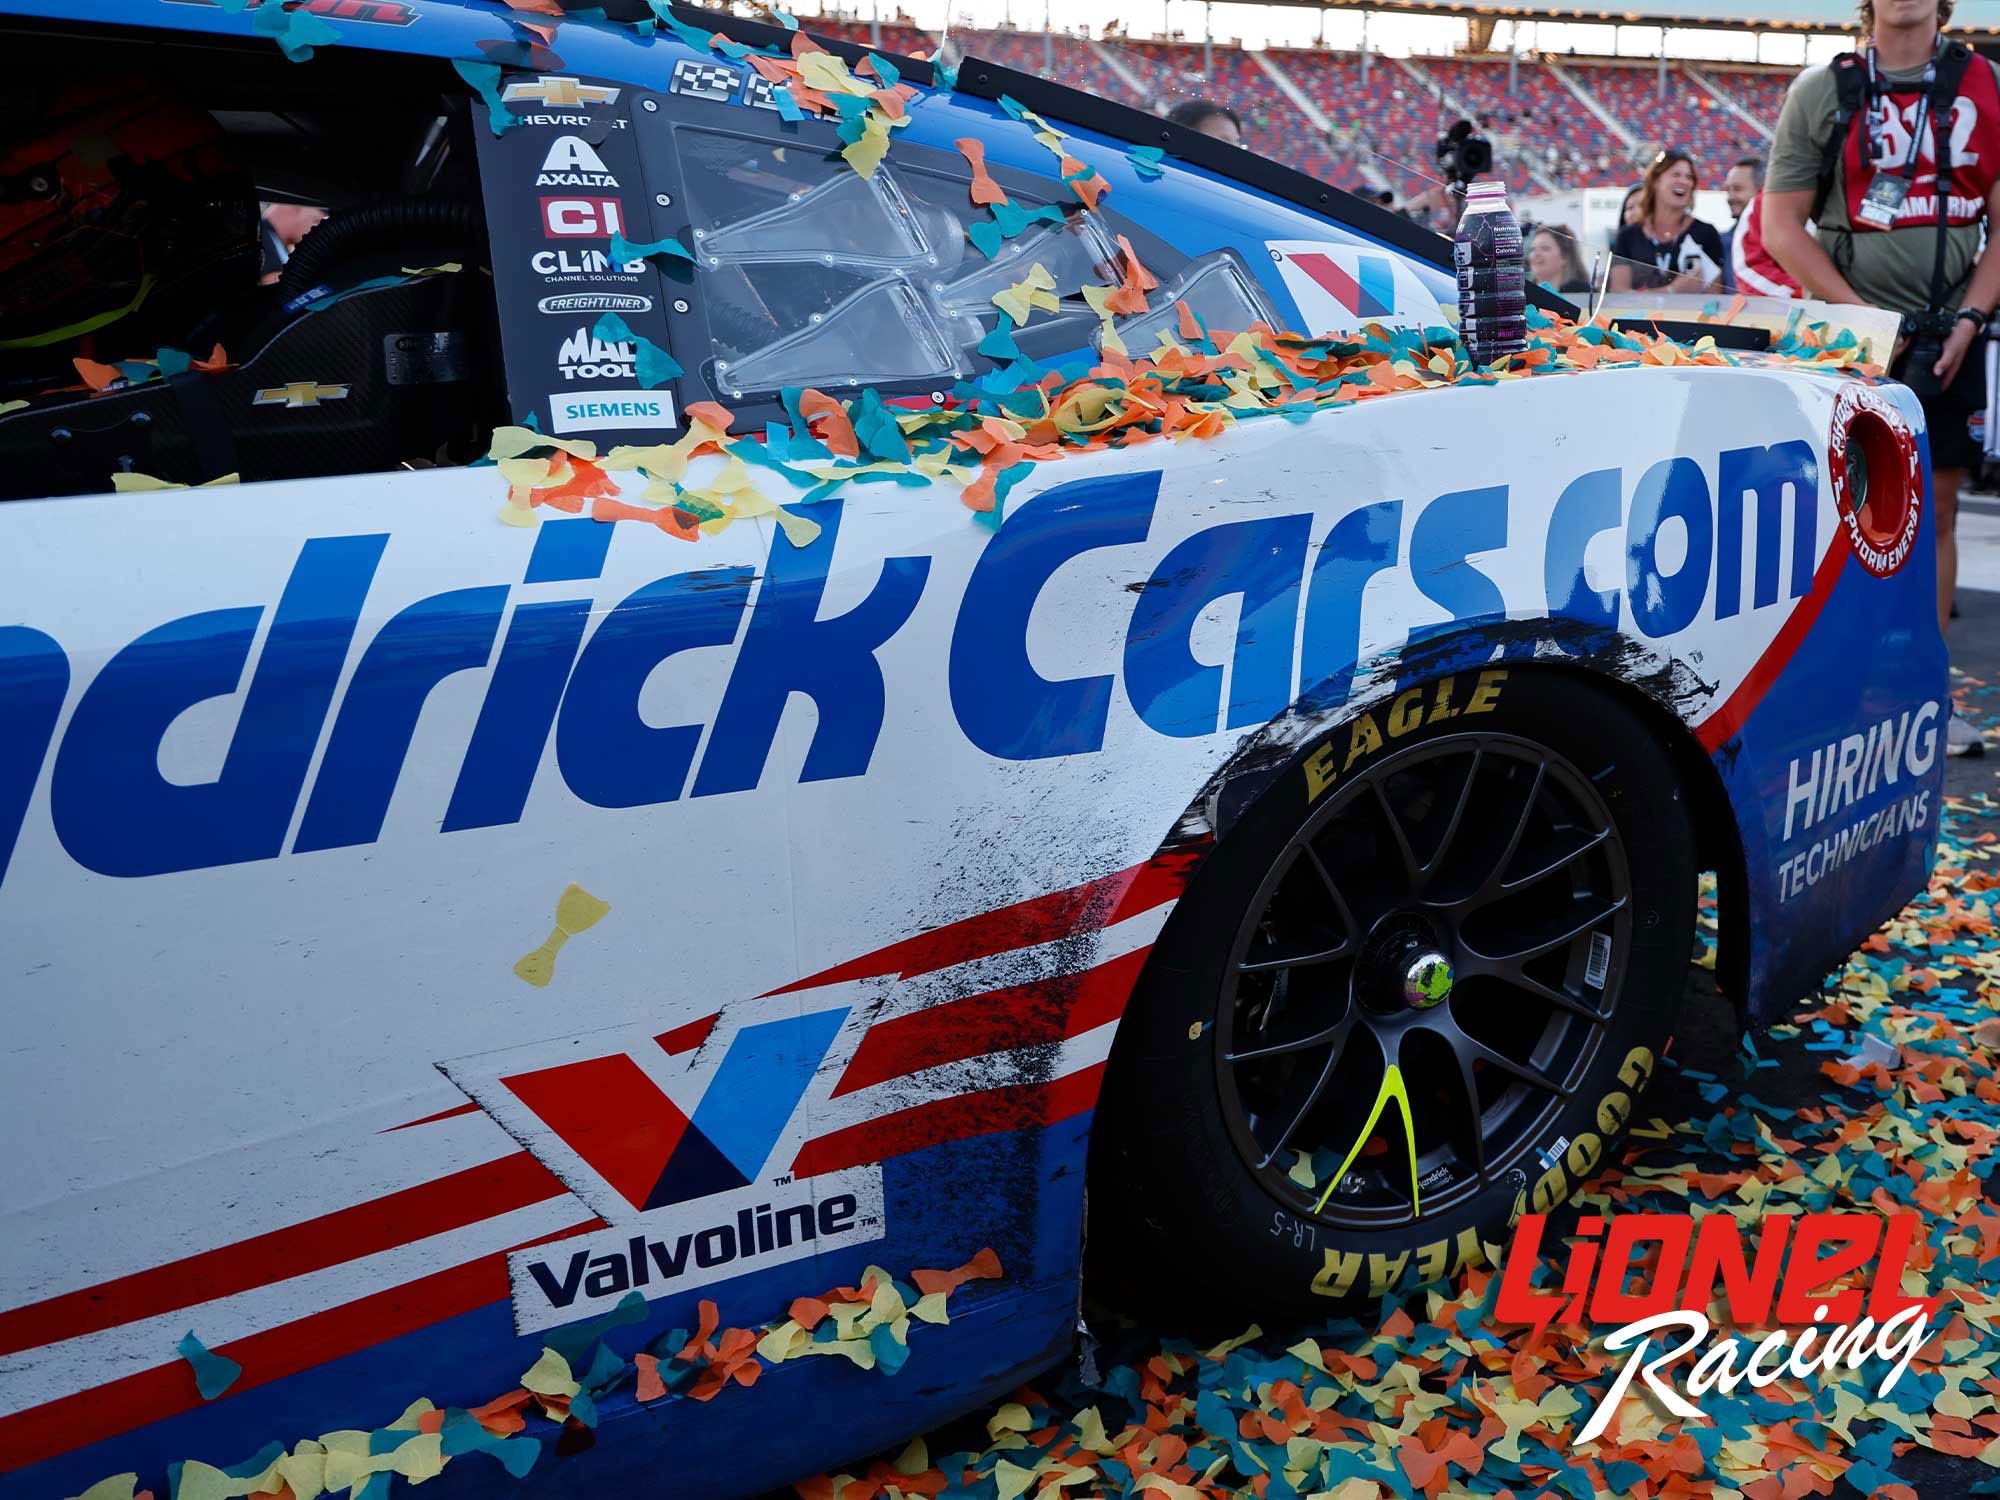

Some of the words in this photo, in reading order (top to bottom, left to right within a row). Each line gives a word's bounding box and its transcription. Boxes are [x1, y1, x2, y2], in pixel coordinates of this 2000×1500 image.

[517, 114, 628, 129] HEVROT
[536, 173, 620, 188] AXALTA
[547, 200, 620, 234] CI
[545, 274, 585, 283] CHANNEL
[589, 274, 639, 283] SOLUTIONS
[550, 297, 642, 310] FREIGHTLINER
[558, 363, 637, 380] TOOL
[566, 402, 661, 419] SIEMENS
[1844, 510, 1887, 573] PHORM
[1888, 487, 1920, 571] ENERGY
[1303, 670, 1508, 804] EAGLE
[1783, 700, 1940, 842] HIRING
[1779, 790, 1931, 904] TECHNICIANS
[1269, 1211, 1316, 1252] LR-5
[526, 1193, 857, 1309] Valvoline
[1310, 1226, 1489, 1299] YEAR
